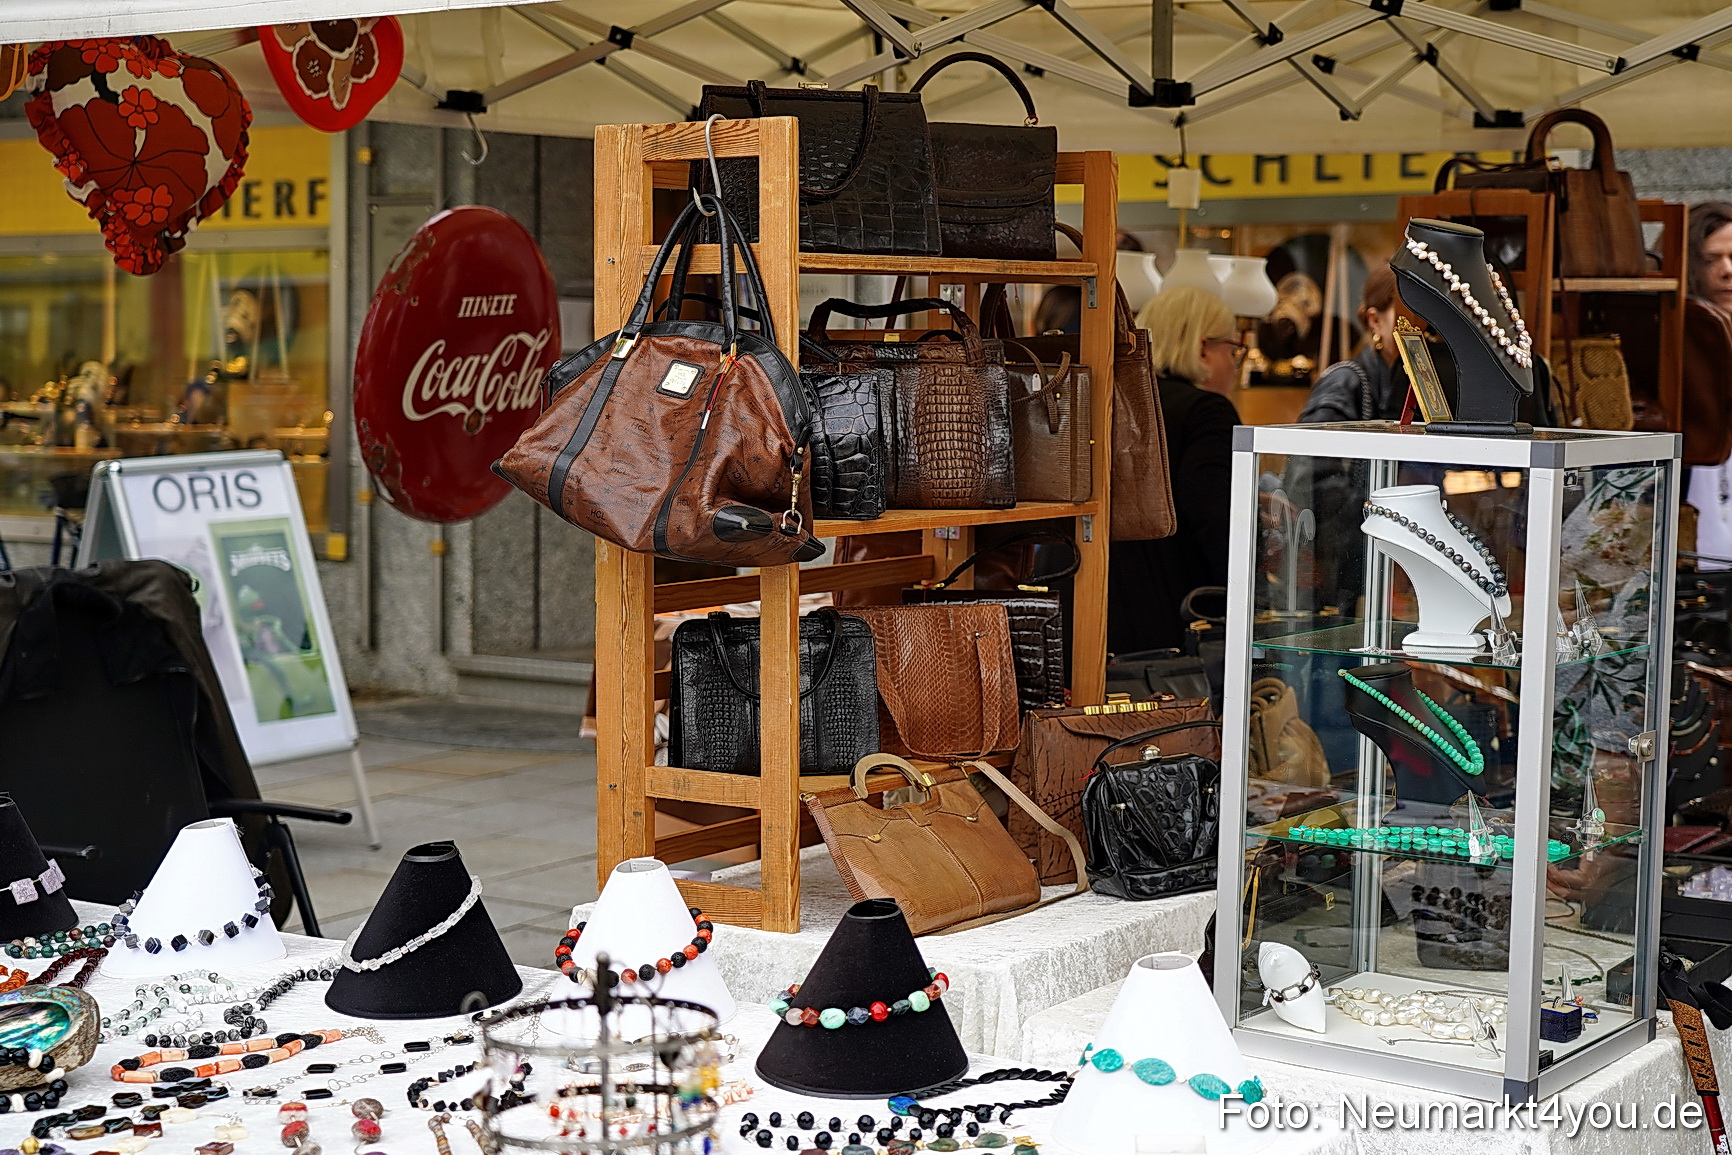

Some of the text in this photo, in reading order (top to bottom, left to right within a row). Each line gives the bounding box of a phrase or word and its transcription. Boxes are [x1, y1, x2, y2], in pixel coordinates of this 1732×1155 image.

[402, 325, 550, 424] Coca-Cola
[153, 472, 262, 513] ORIS
[590, 508, 606, 521] HCL
